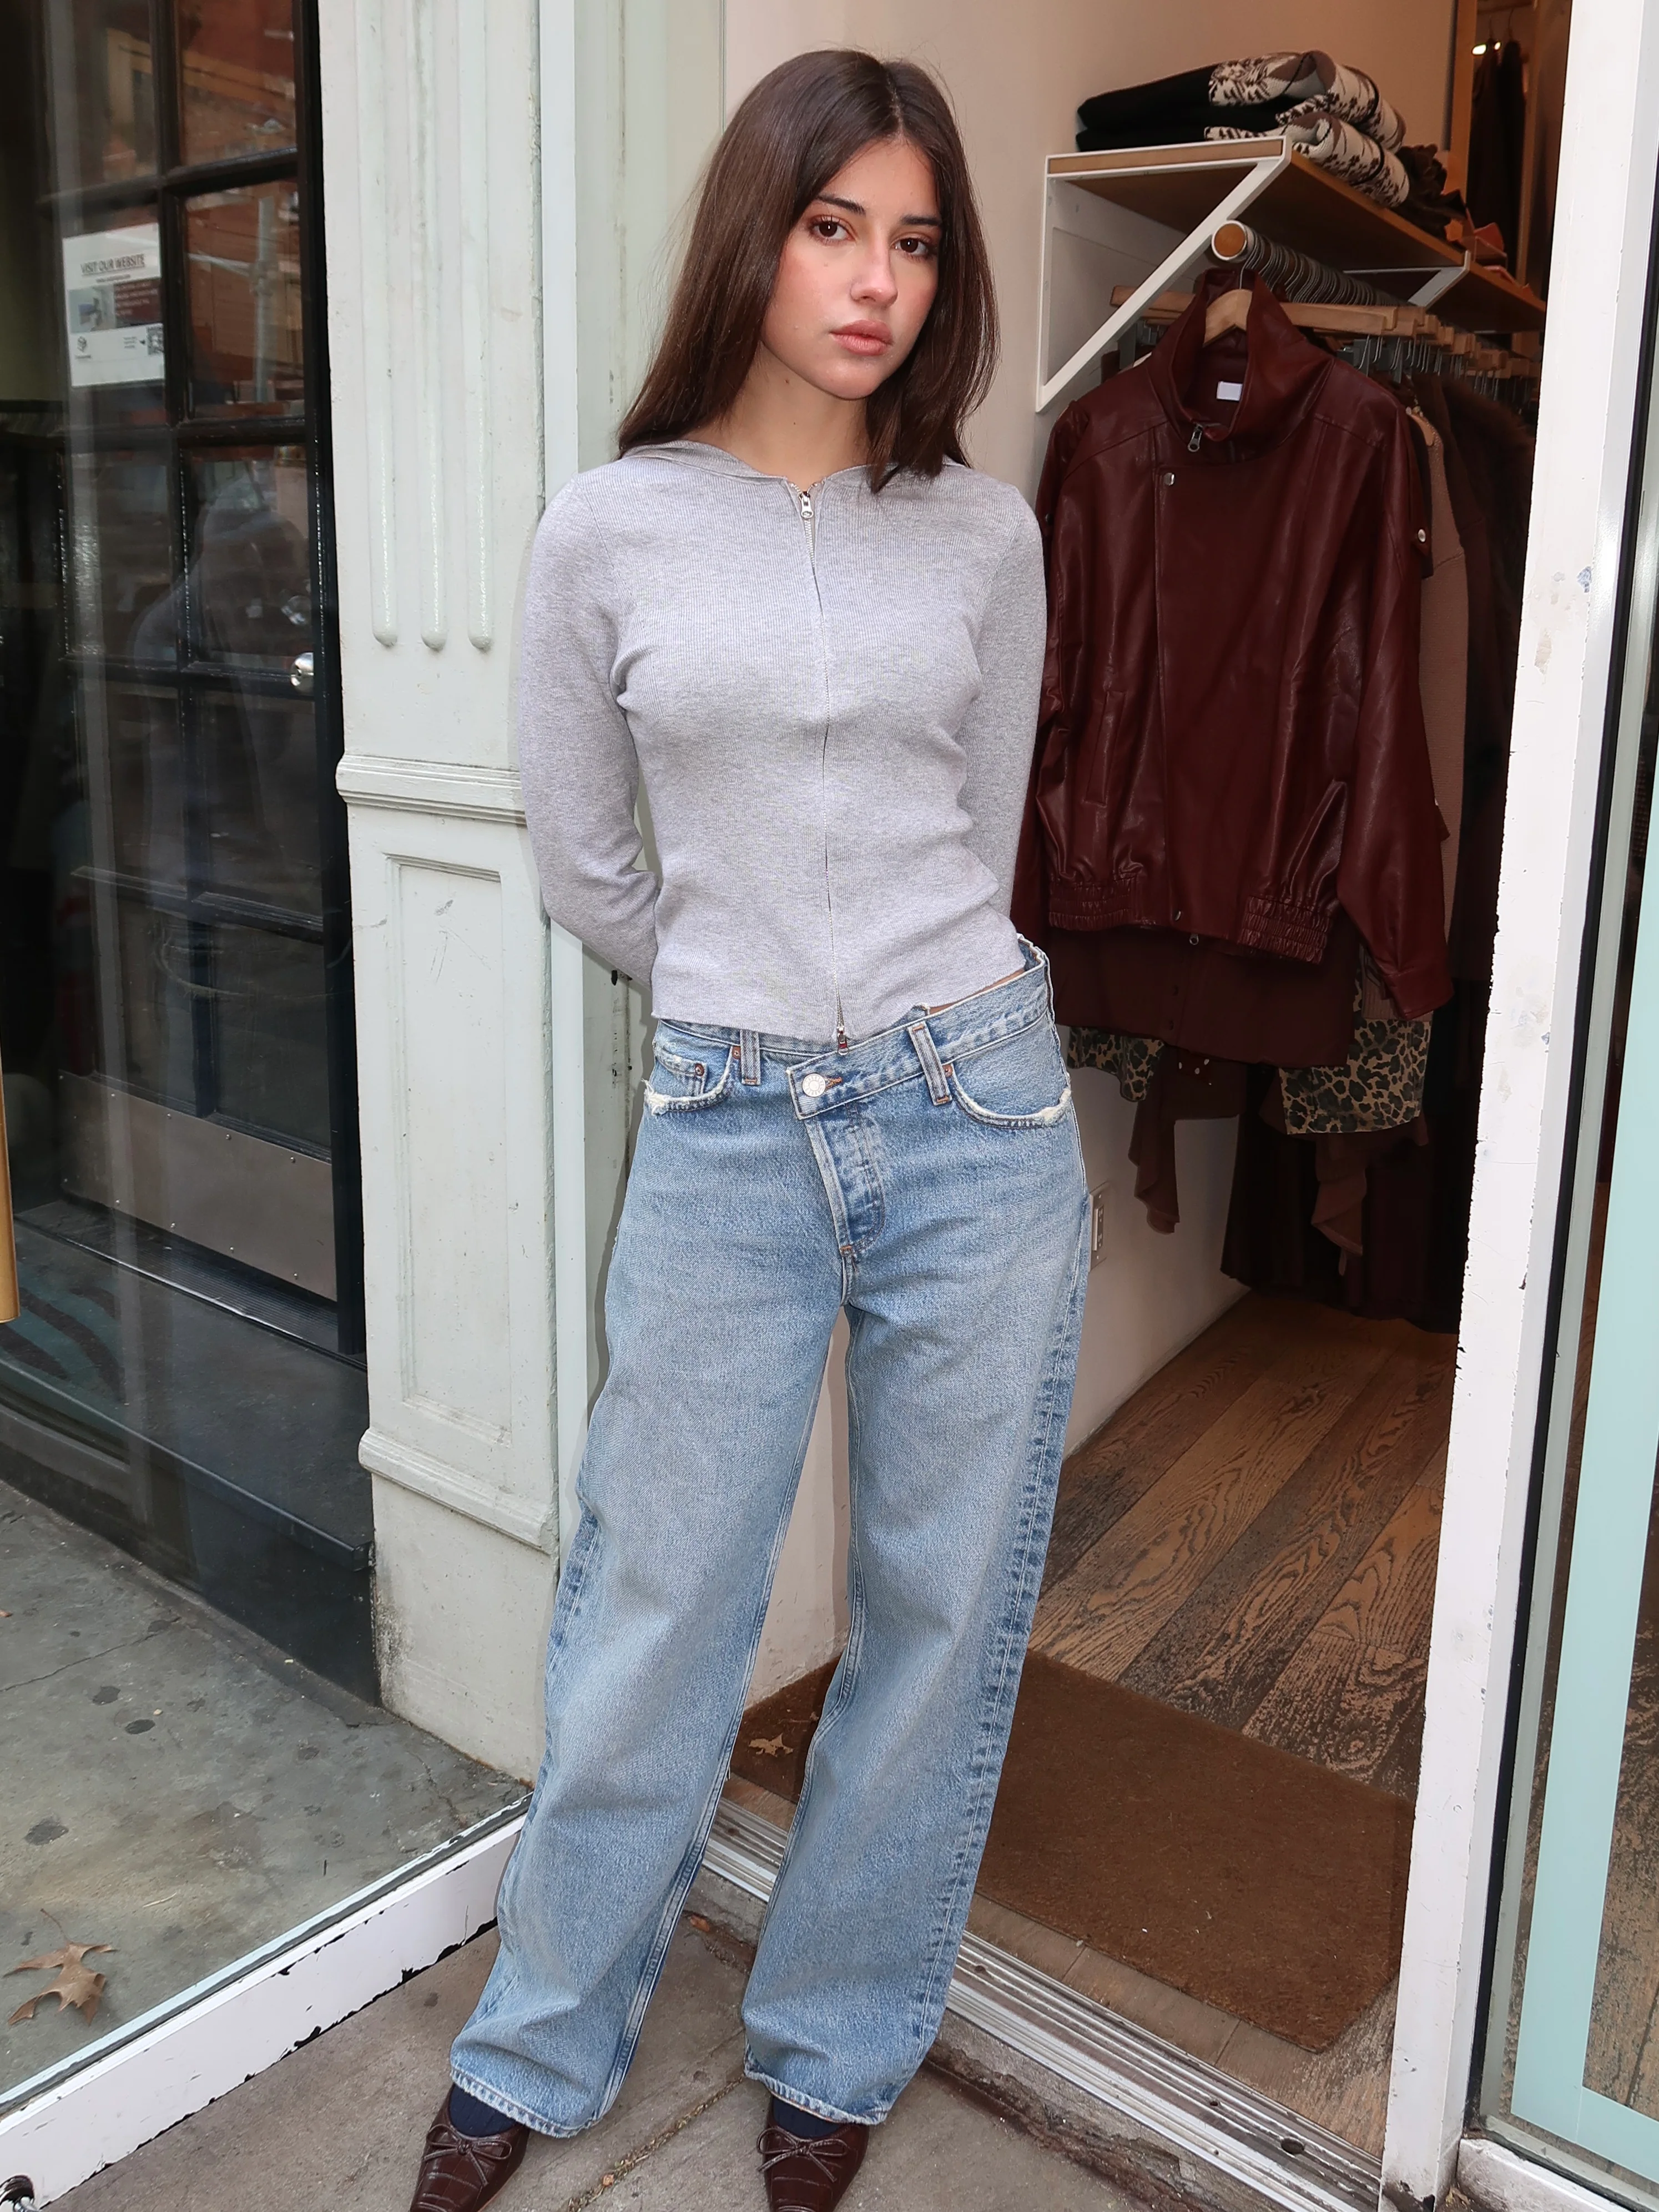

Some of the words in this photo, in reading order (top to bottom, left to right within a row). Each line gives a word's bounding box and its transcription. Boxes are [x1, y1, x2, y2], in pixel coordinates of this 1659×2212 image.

[81, 261, 97, 274] VISIT
[98, 259, 114, 271] OUR
[114, 254, 145, 268] WEBSITE
